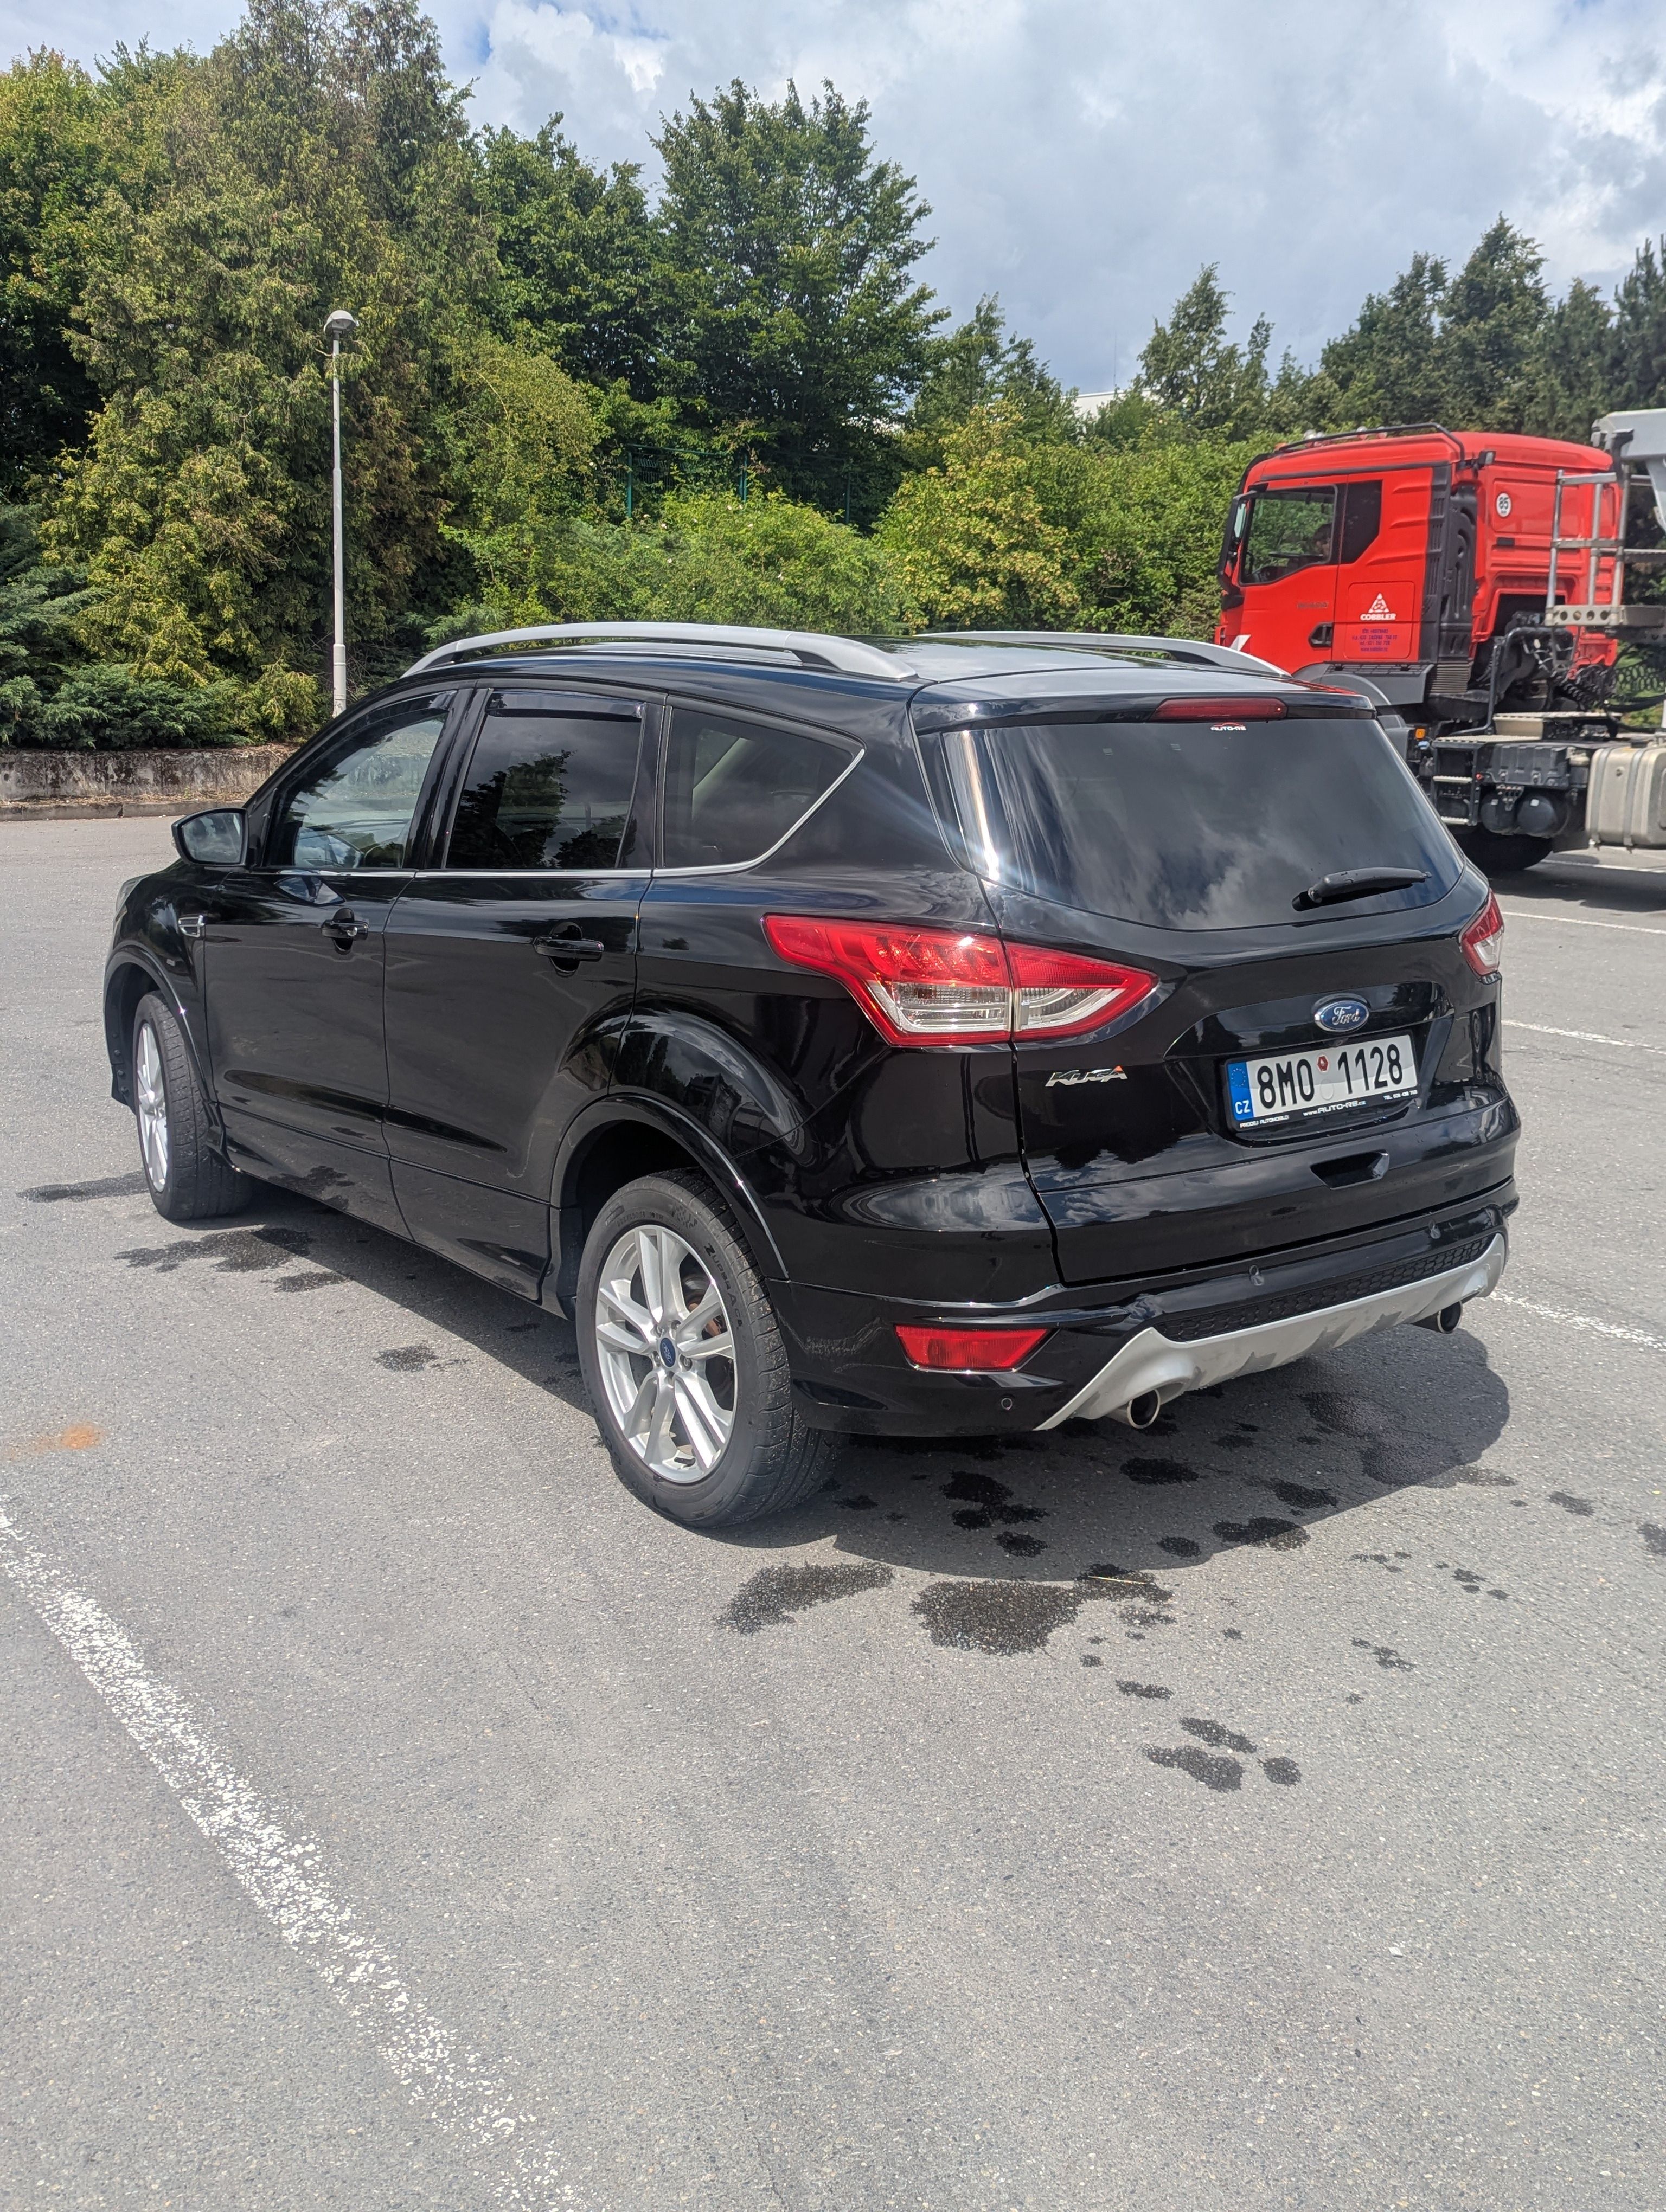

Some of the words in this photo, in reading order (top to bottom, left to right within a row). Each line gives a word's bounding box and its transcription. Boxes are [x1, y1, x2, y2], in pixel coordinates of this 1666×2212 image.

[1498, 497, 1509, 510] 85
[1332, 1006, 1360, 1025] Ford
[1045, 1065, 1128, 1087] KUGA
[1337, 1044, 1403, 1094] 1128
[1235, 1099, 1251, 1115] CZ
